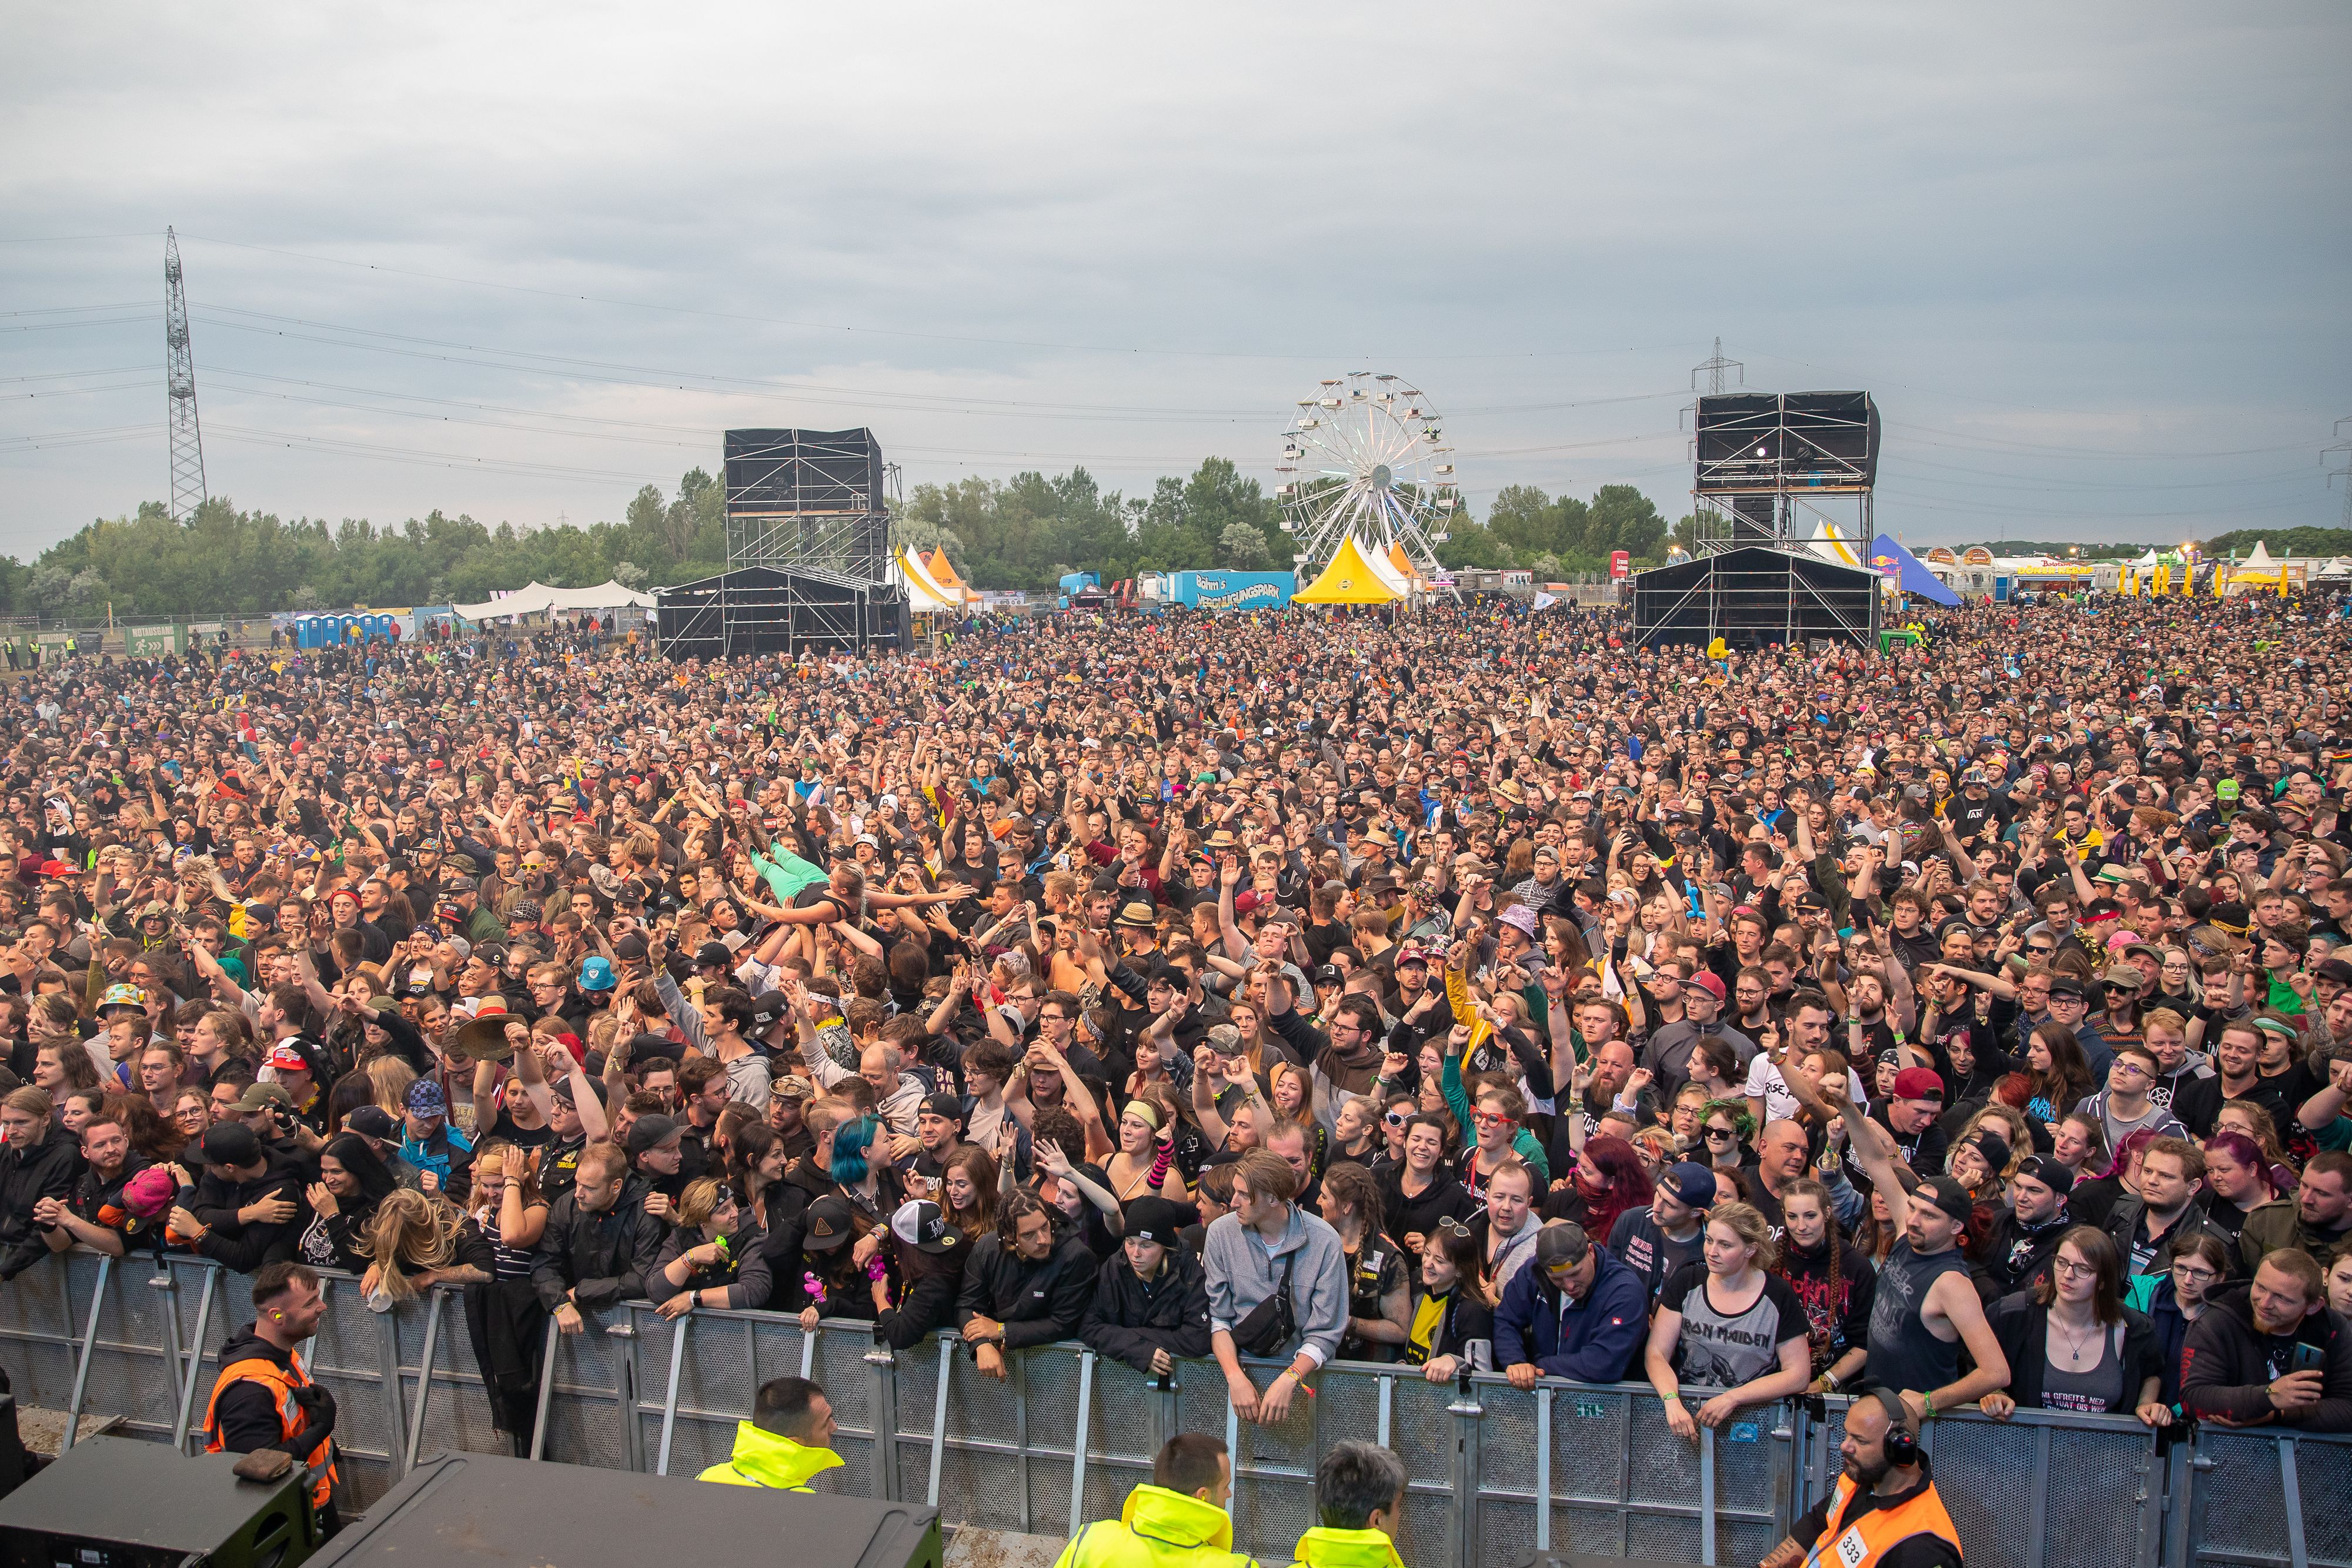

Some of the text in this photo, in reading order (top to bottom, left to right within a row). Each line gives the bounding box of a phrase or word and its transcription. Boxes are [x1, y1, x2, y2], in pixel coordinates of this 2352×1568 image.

[1197, 583, 1281, 609] VERGNÜGUNGSPARK
[132, 626, 175, 637] NOTAUSGANG
[1163, 790, 1172, 798] HOT
[1967, 808, 1983, 819] VAN
[1765, 1082, 1785, 1096] RISE
[1716, 1325, 1770, 1350] MAIDEN
[2089, 1397, 2105, 1405] NED
[1842, 1535, 1860, 1564] 333
